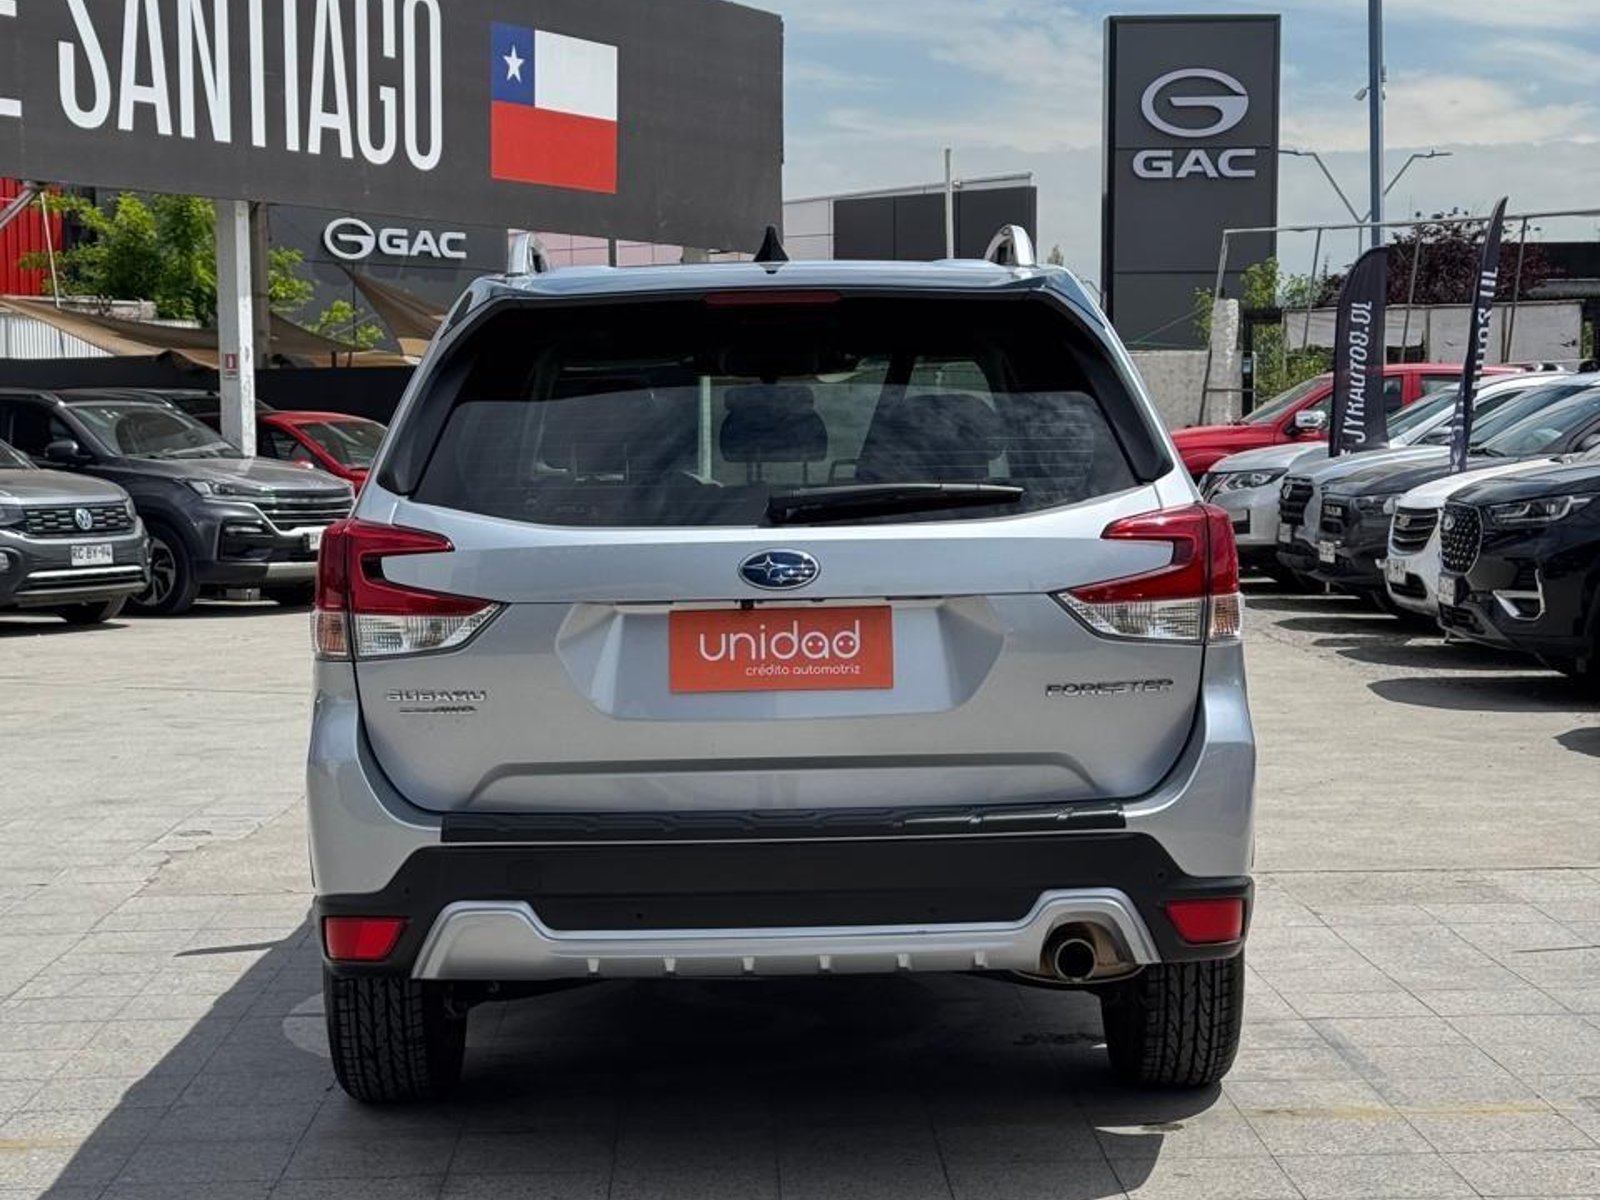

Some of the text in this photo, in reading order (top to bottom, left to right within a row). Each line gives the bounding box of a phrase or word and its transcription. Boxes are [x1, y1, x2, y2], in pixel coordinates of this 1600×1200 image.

[58, 0, 444, 171] SANTIAGO
[1132, 148, 1257, 179] GAC
[378, 228, 468, 260] GAC
[699, 619, 861, 661] unidad
[745, 663, 861, 677] crédito automotriz
[386, 688, 488, 702] SUBARU
[1045, 678, 1175, 698] FORESTER
